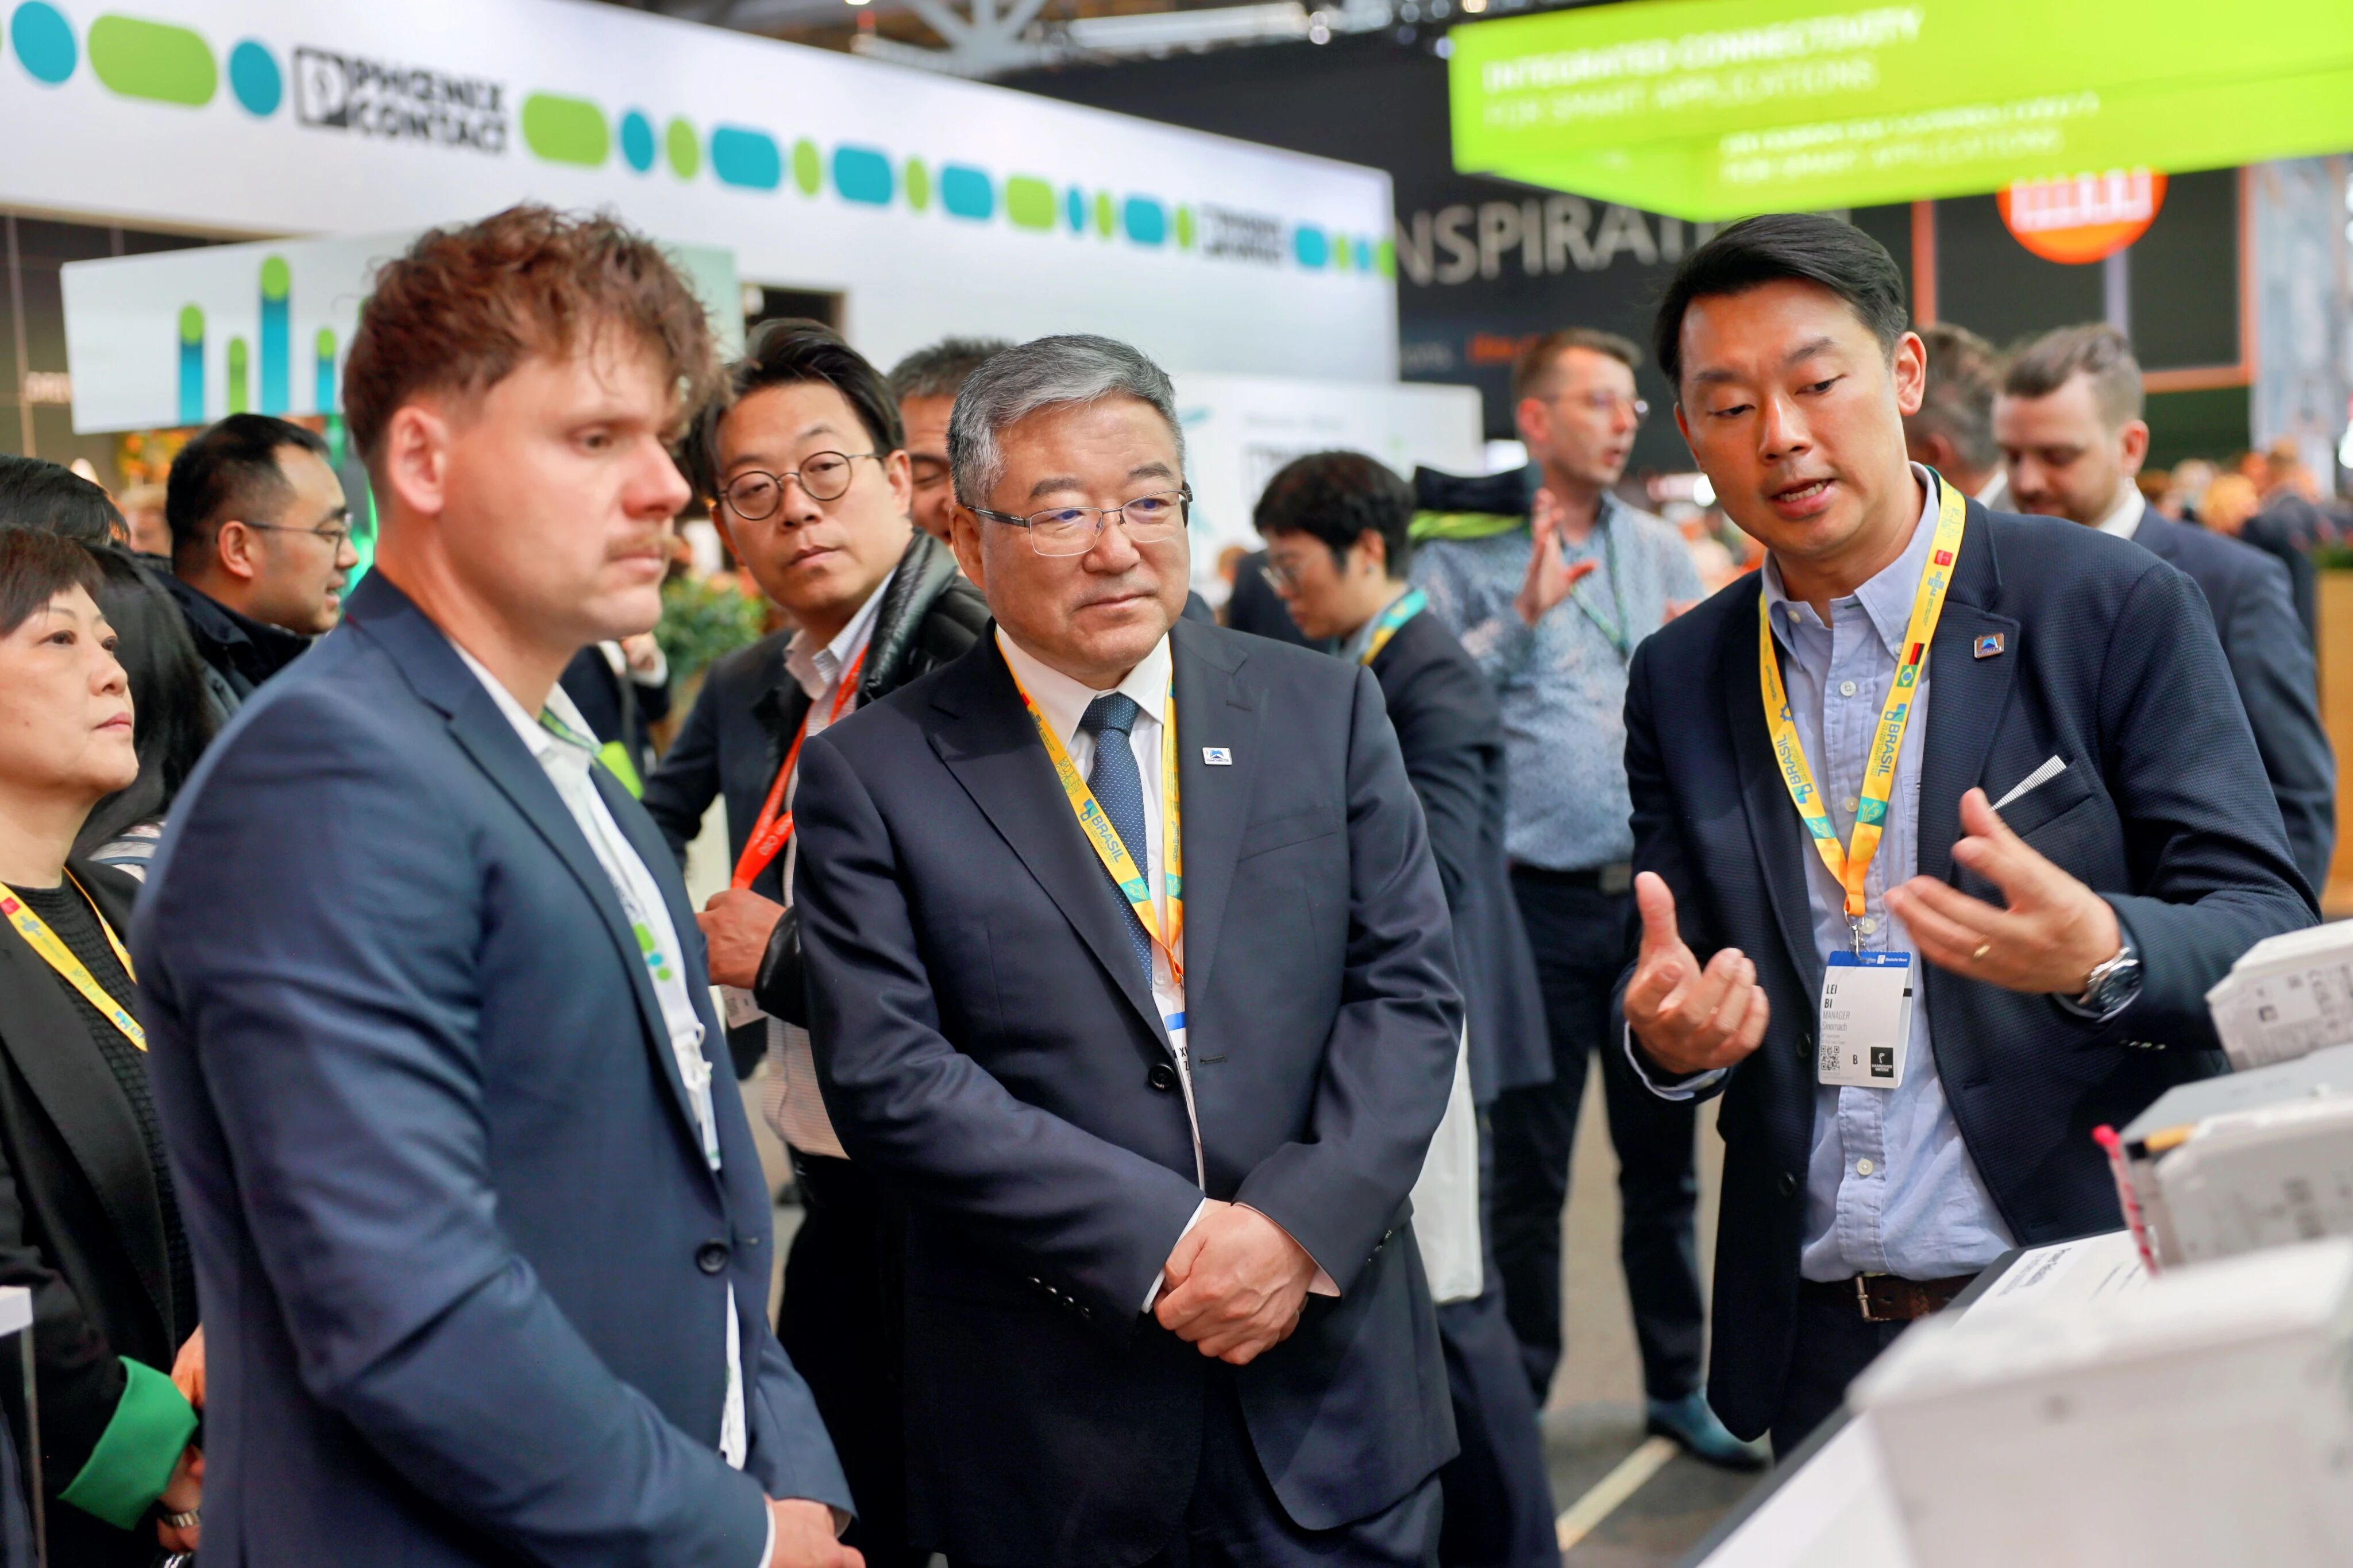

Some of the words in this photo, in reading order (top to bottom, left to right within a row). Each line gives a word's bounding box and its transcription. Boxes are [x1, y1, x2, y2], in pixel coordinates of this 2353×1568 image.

[1482, 38, 1673, 94] INTEGRATED
[1676, 7, 1924, 69] CONNECTIVITY
[347, 56, 504, 113] PHOENIX
[350, 99, 508, 156] CONTACT
[1777, 734, 1802, 785] BRASIL
[1877, 724, 1900, 777] BRASIL
[1091, 816, 1124, 863] BRASIL
[1824, 998, 1833, 1009] BI
[1826, 984, 1838, 995] LEI
[1822, 1022, 1847, 1032] Sinomach
[1823, 1010, 1850, 1020] MANAGER
[1853, 1055, 1858, 1065] B
